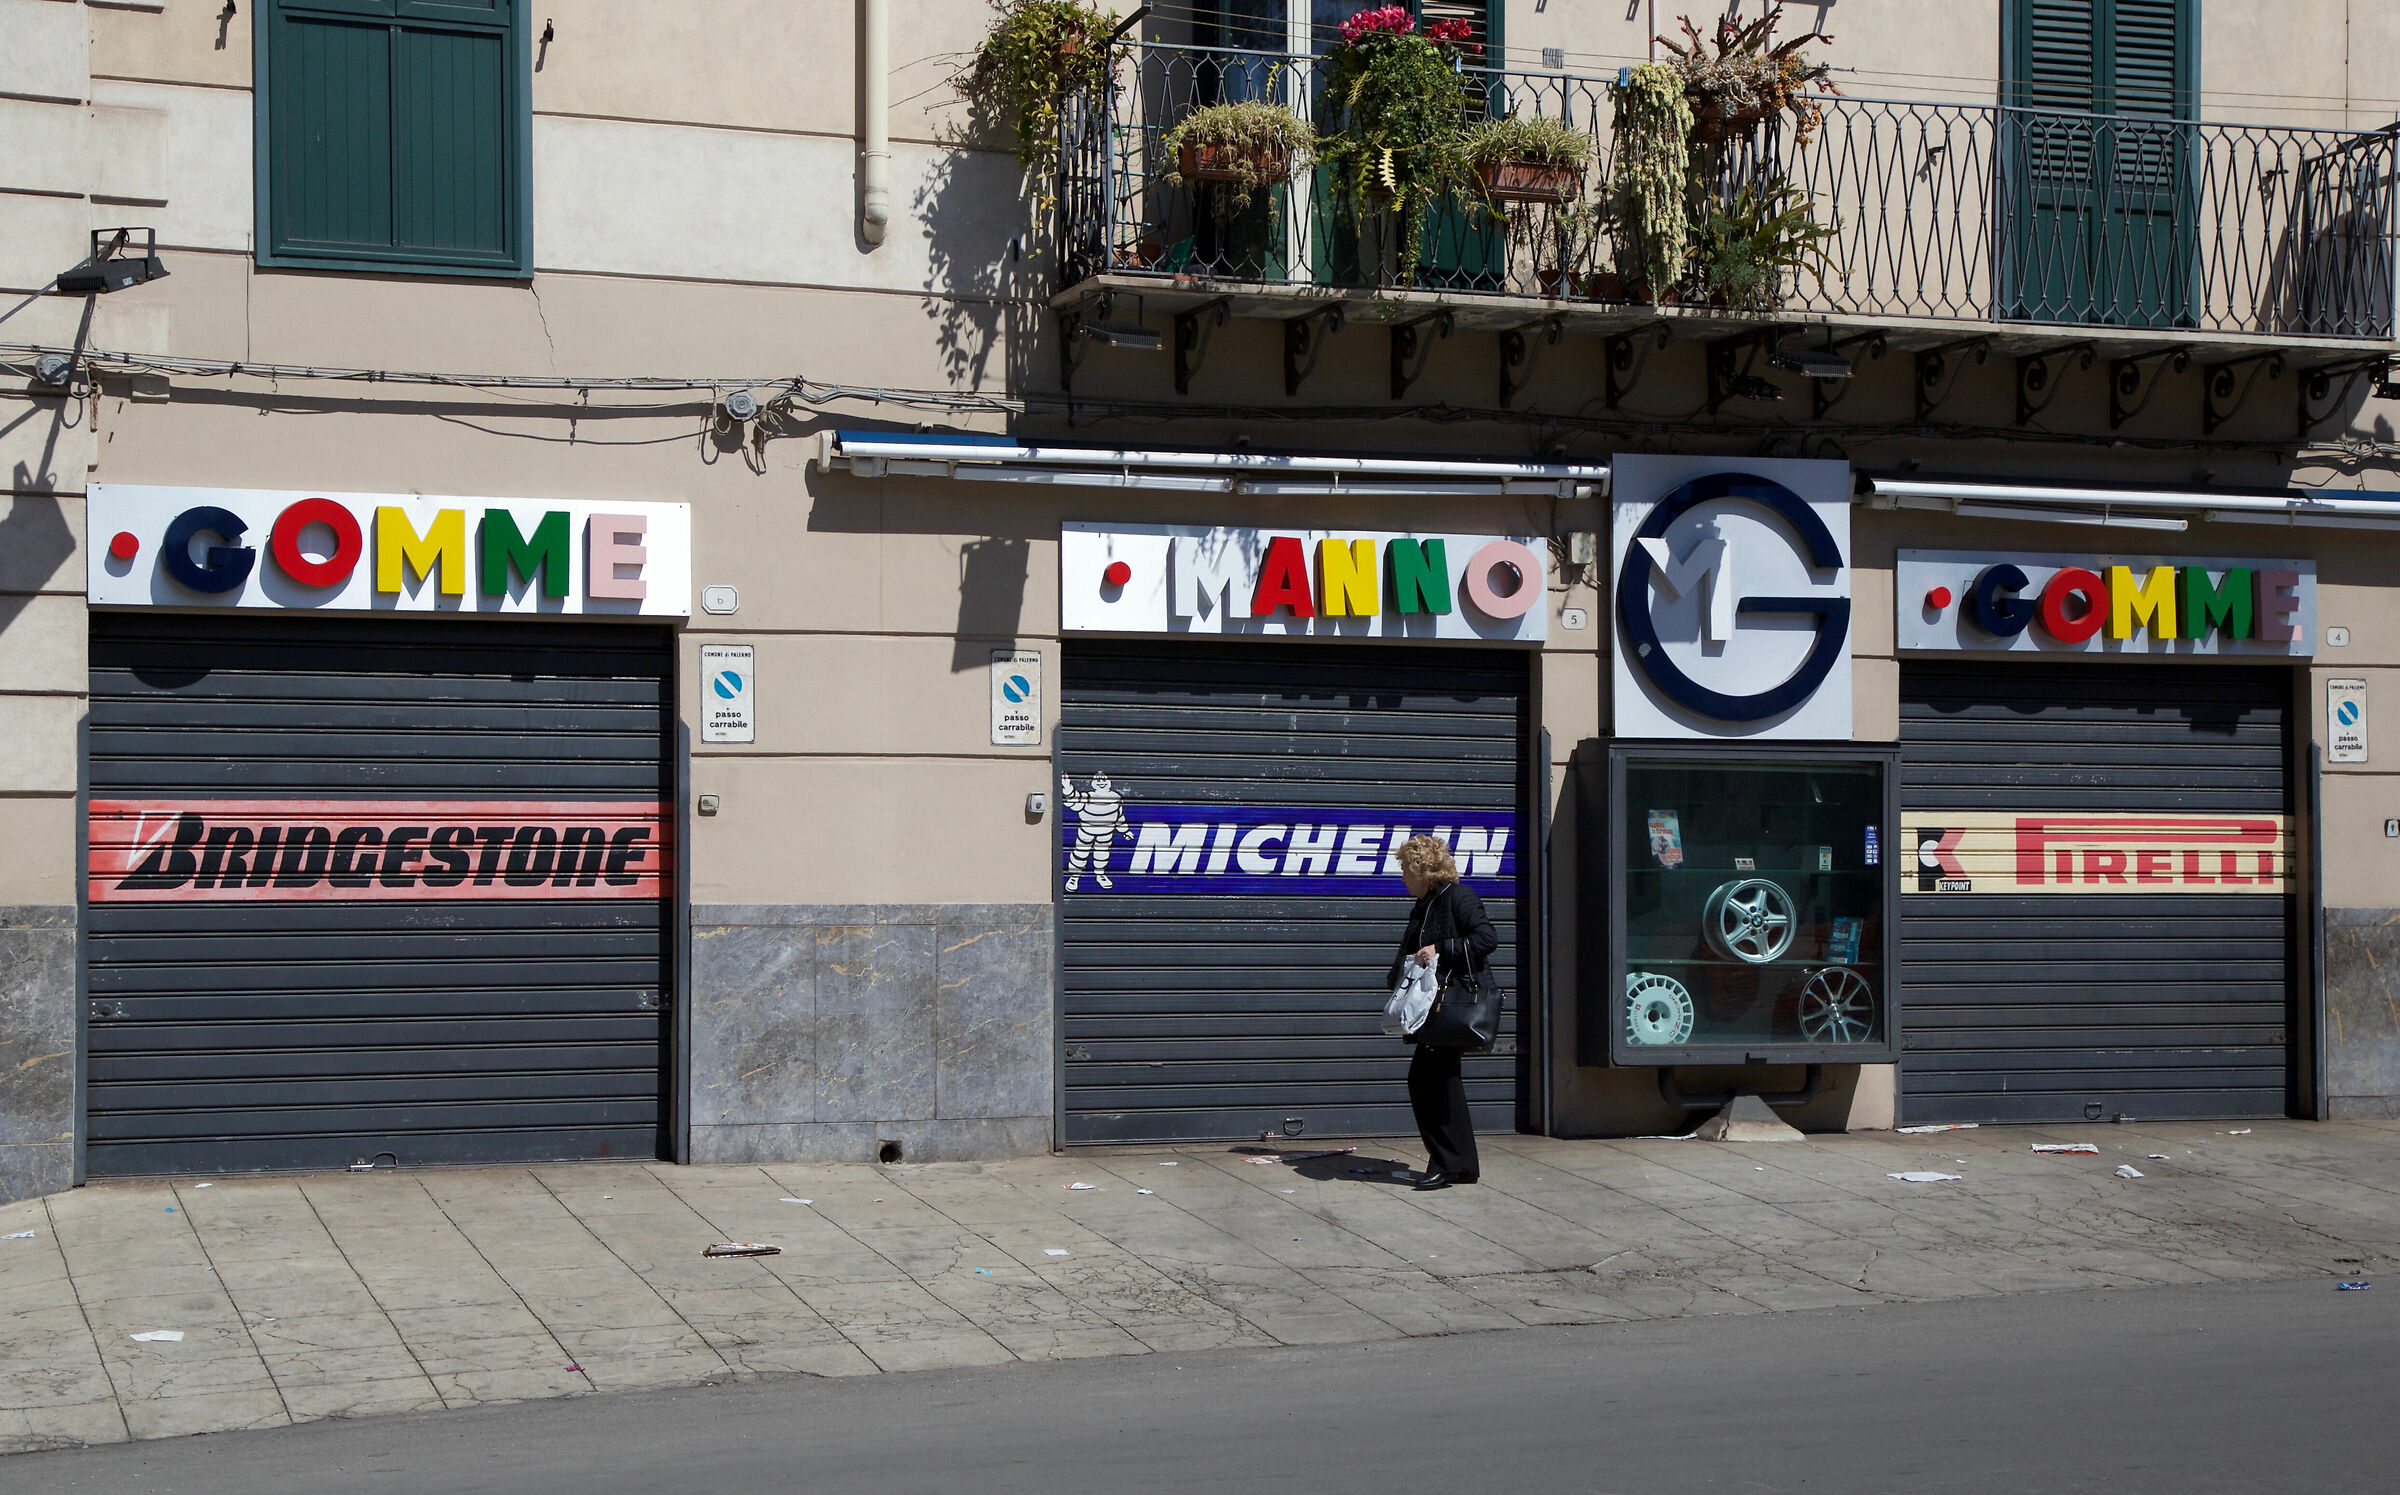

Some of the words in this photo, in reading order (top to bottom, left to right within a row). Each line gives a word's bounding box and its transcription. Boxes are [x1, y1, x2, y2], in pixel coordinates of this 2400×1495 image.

[163, 498, 648, 600] GOMME
[1168, 536, 1541, 620] MANNO
[1571, 615, 1578, 625] 5
[1977, 562, 2303, 644] GOMME
[715, 711, 742, 719] passo
[2334, 743, 2363, 751] carrabile
[115, 810, 652, 891] BRIDGESTONE
[2015, 817, 2278, 885] PIRELLI
[1939, 881, 1971, 891] KEYPOINT
